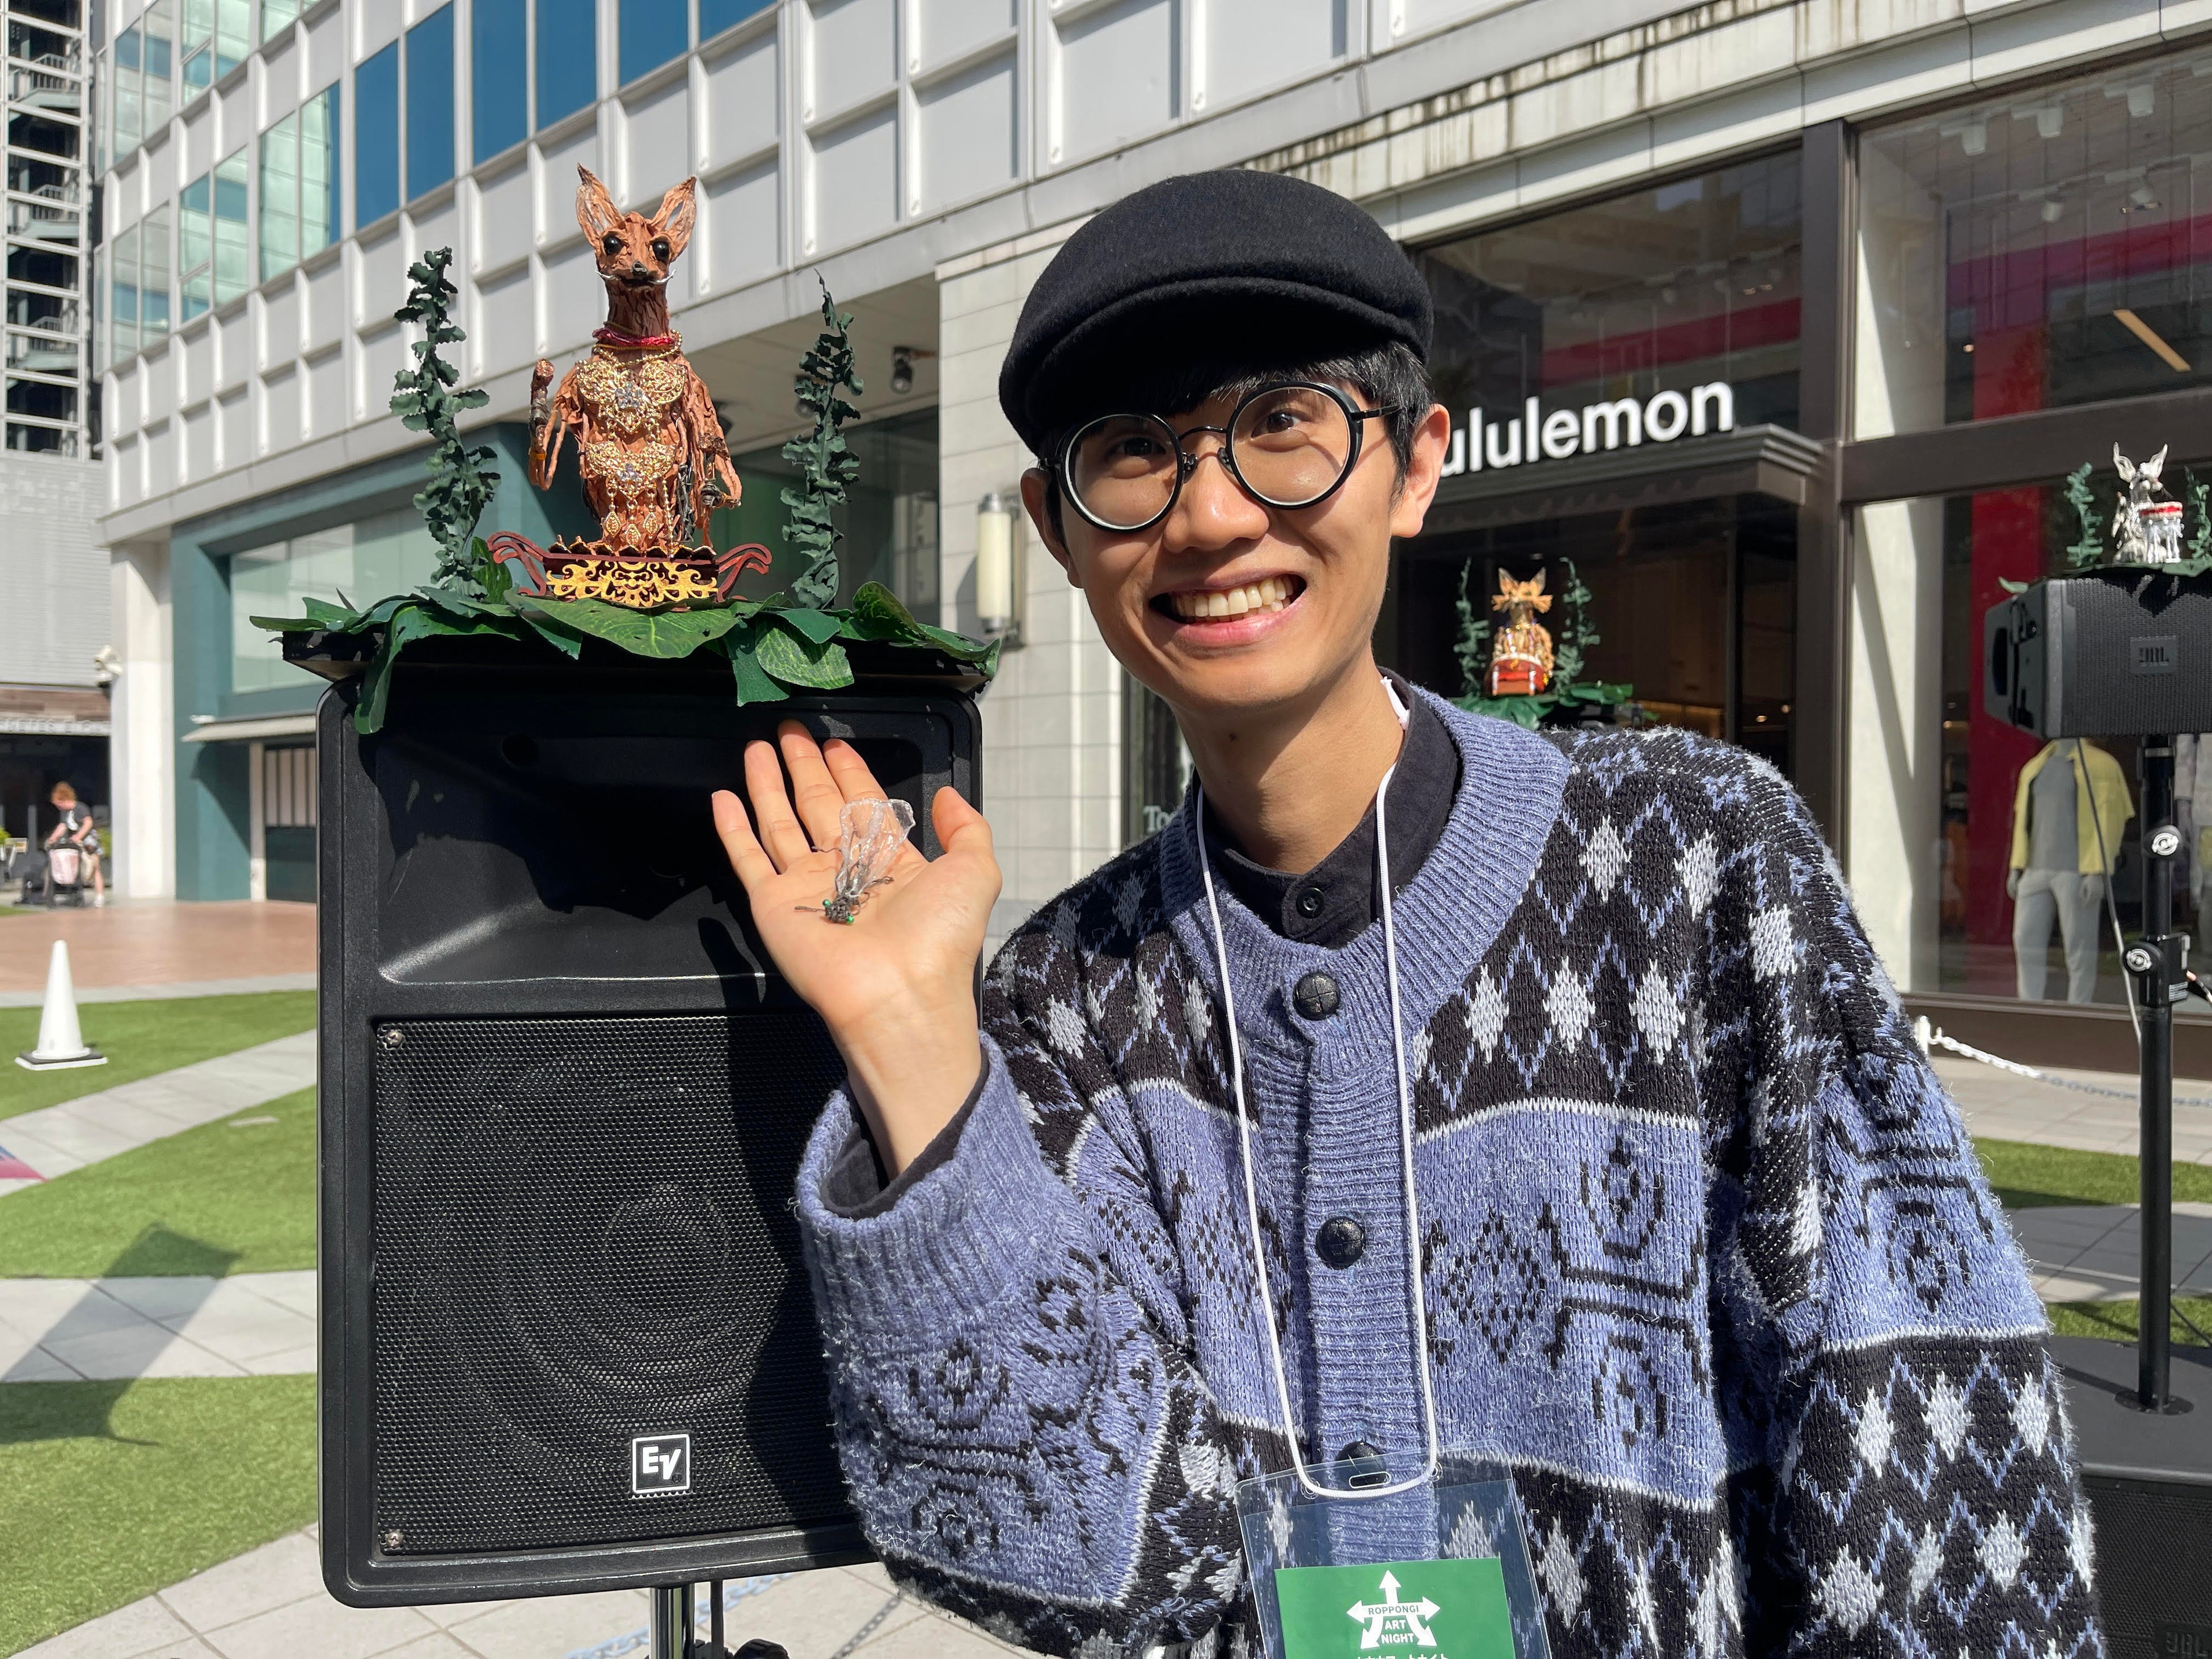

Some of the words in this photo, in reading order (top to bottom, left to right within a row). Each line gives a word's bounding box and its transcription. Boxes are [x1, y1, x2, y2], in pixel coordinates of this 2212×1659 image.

[1368, 1605, 1419, 1615] ROPPONGI
[1385, 1619, 1406, 1630] ART
[1381, 1633, 1415, 1644] NIGHT
